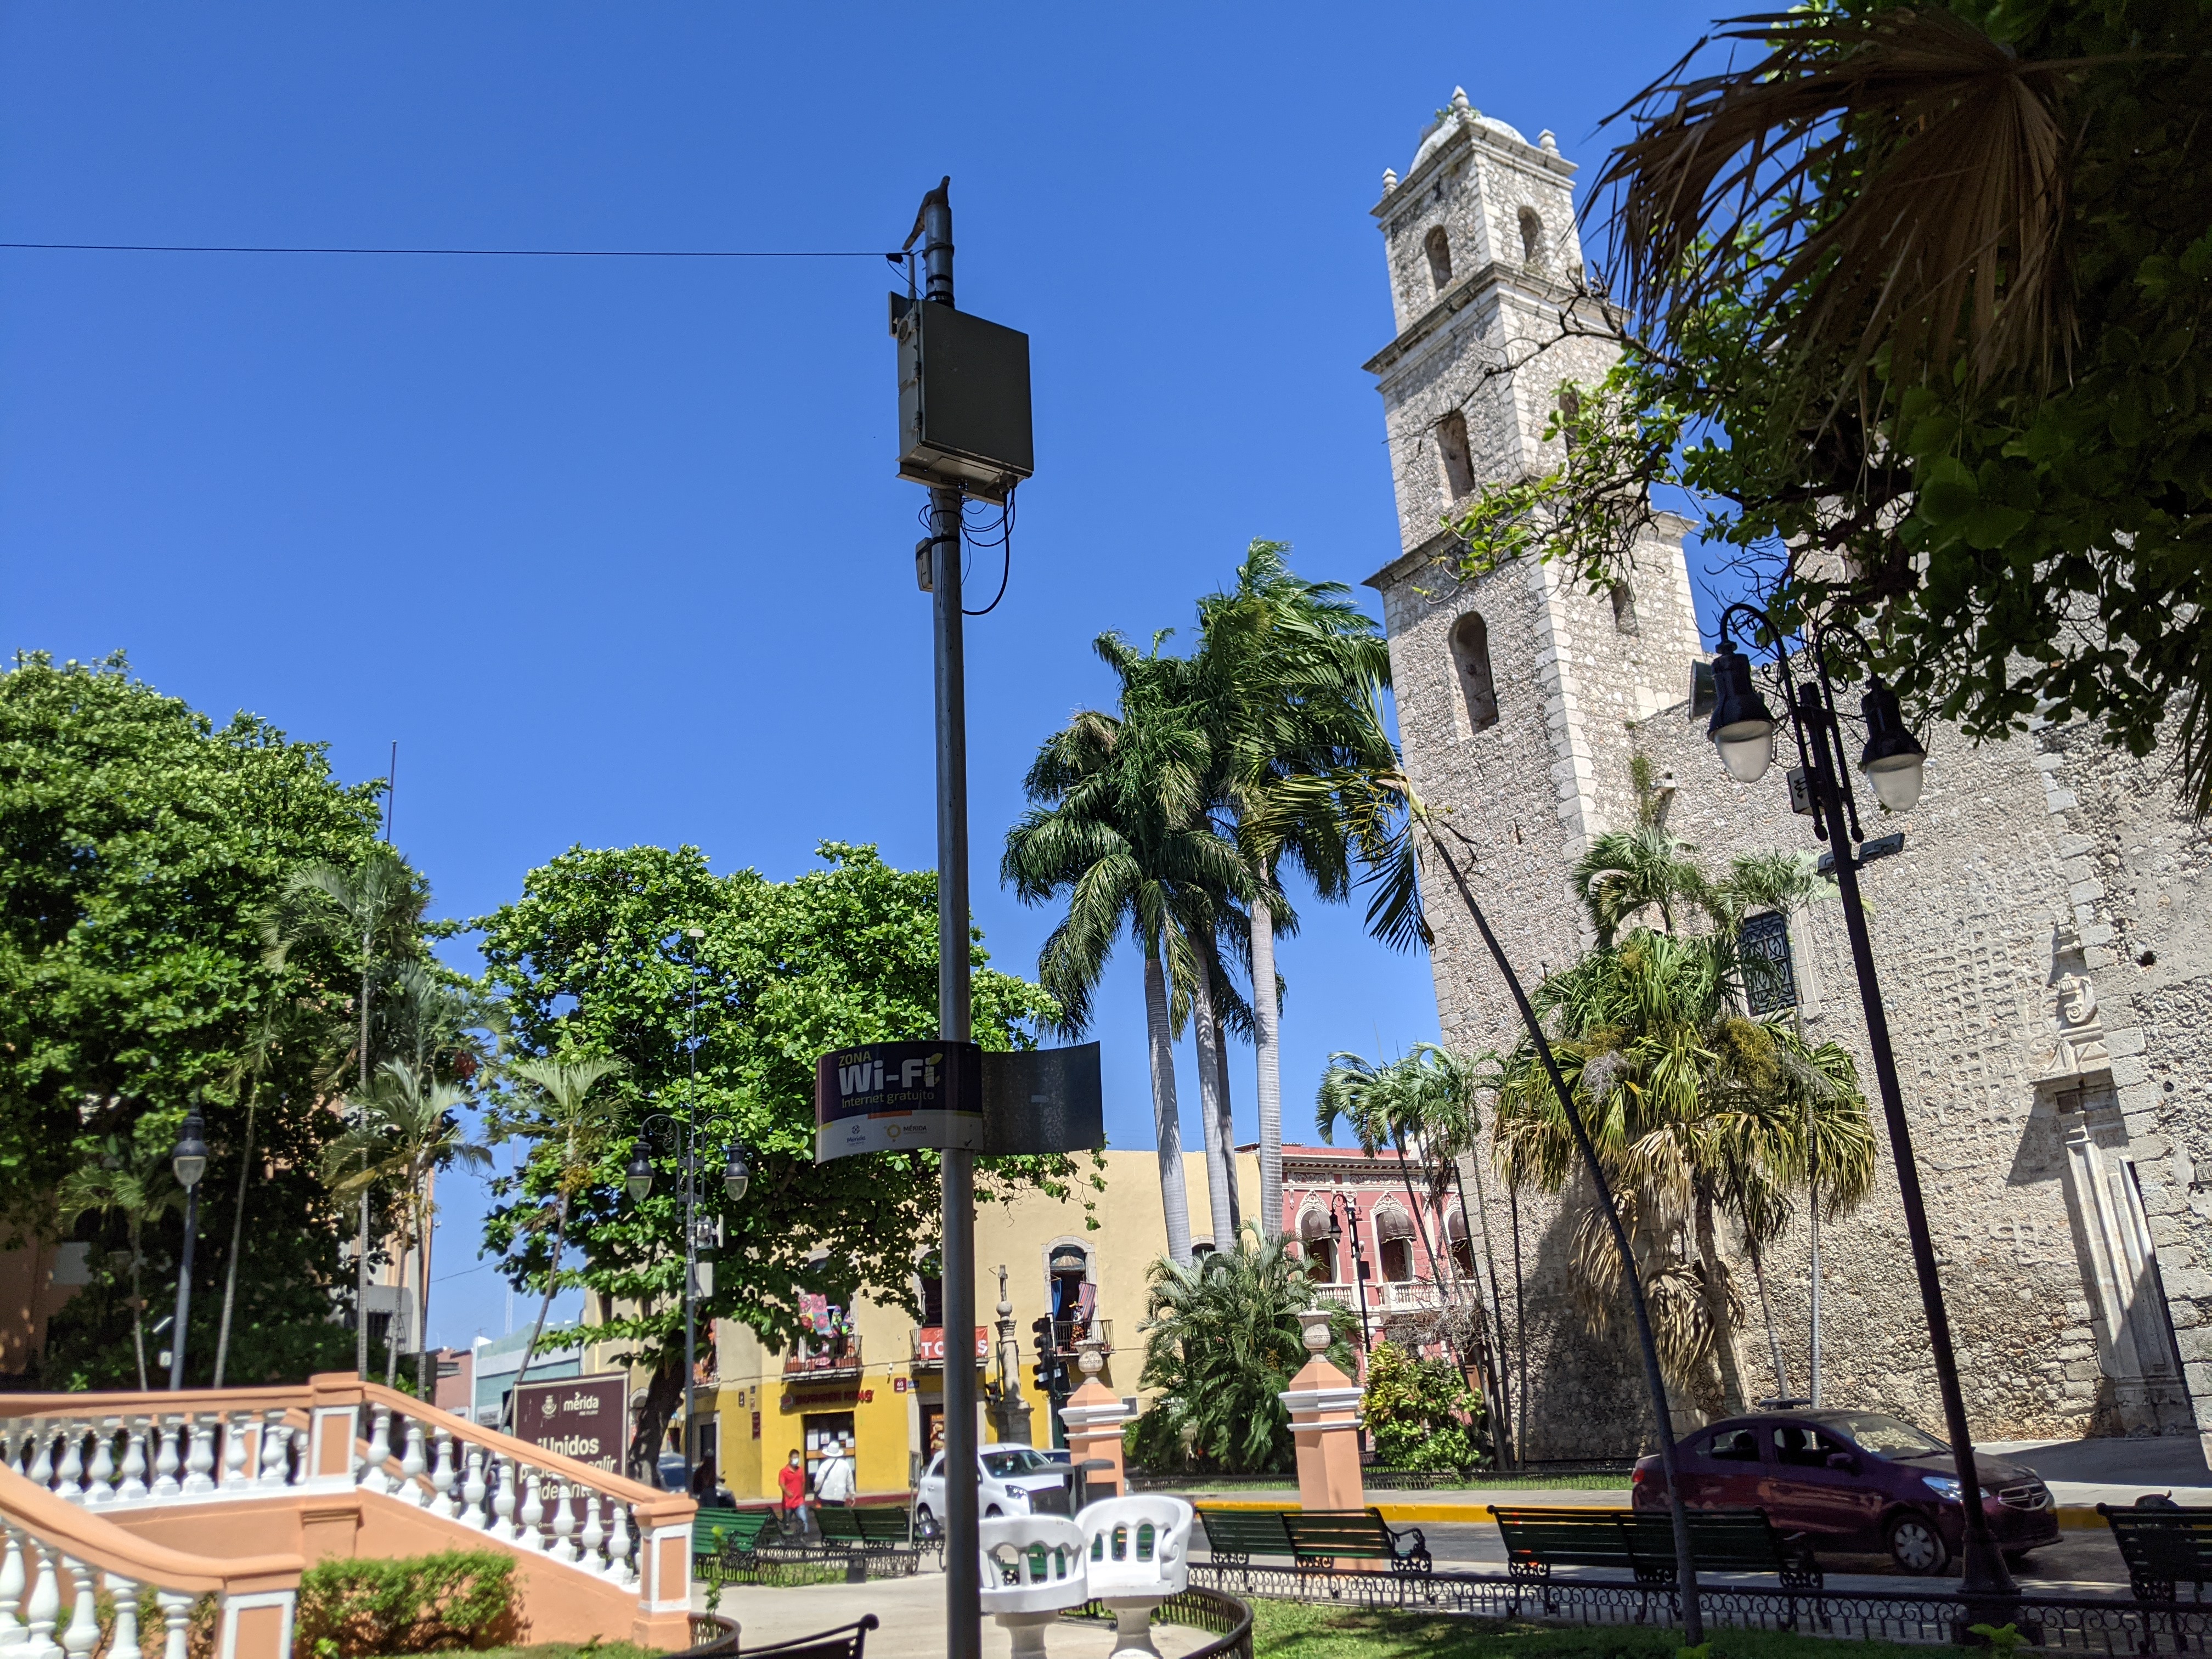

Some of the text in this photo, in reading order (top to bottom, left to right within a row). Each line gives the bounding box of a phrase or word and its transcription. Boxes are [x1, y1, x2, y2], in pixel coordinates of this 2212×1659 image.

[839, 1051, 872, 1067] ZONA
[839, 1058, 934, 1096] Wi-Fi
[842, 1090, 934, 1108] Internet gratuito
[921, 1339, 988, 1357] TOS
[563, 1391, 599, 1411] mérida
